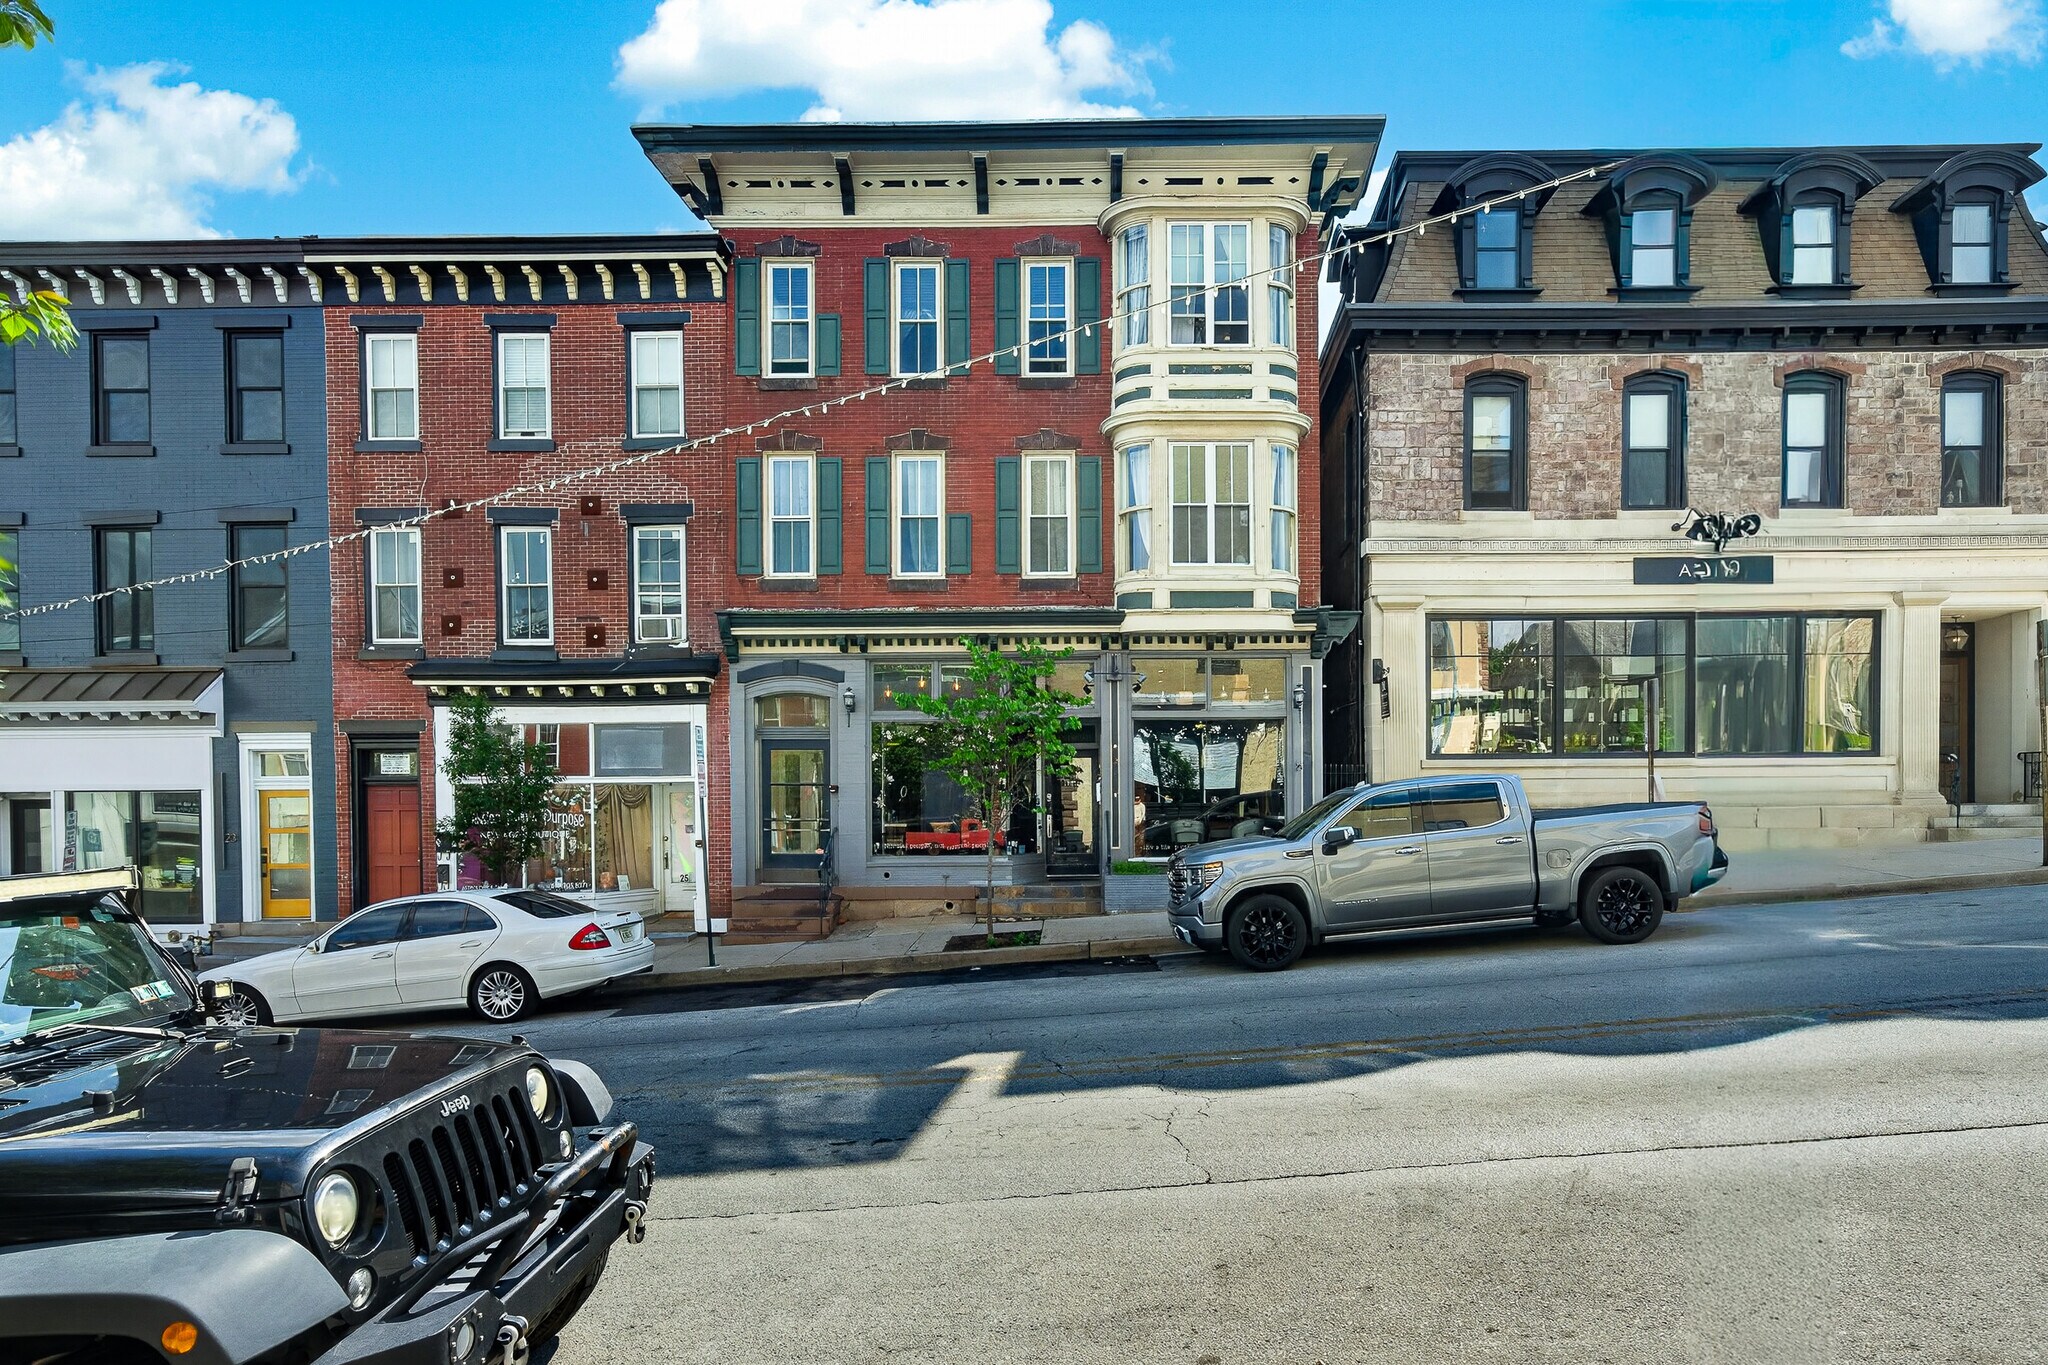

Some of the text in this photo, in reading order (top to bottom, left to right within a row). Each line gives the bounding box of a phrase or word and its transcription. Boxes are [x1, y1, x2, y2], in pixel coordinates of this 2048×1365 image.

[543, 808, 585, 829] Purpose
[680, 873, 689, 882] 25
[440, 1094, 470, 1117] Jeep
